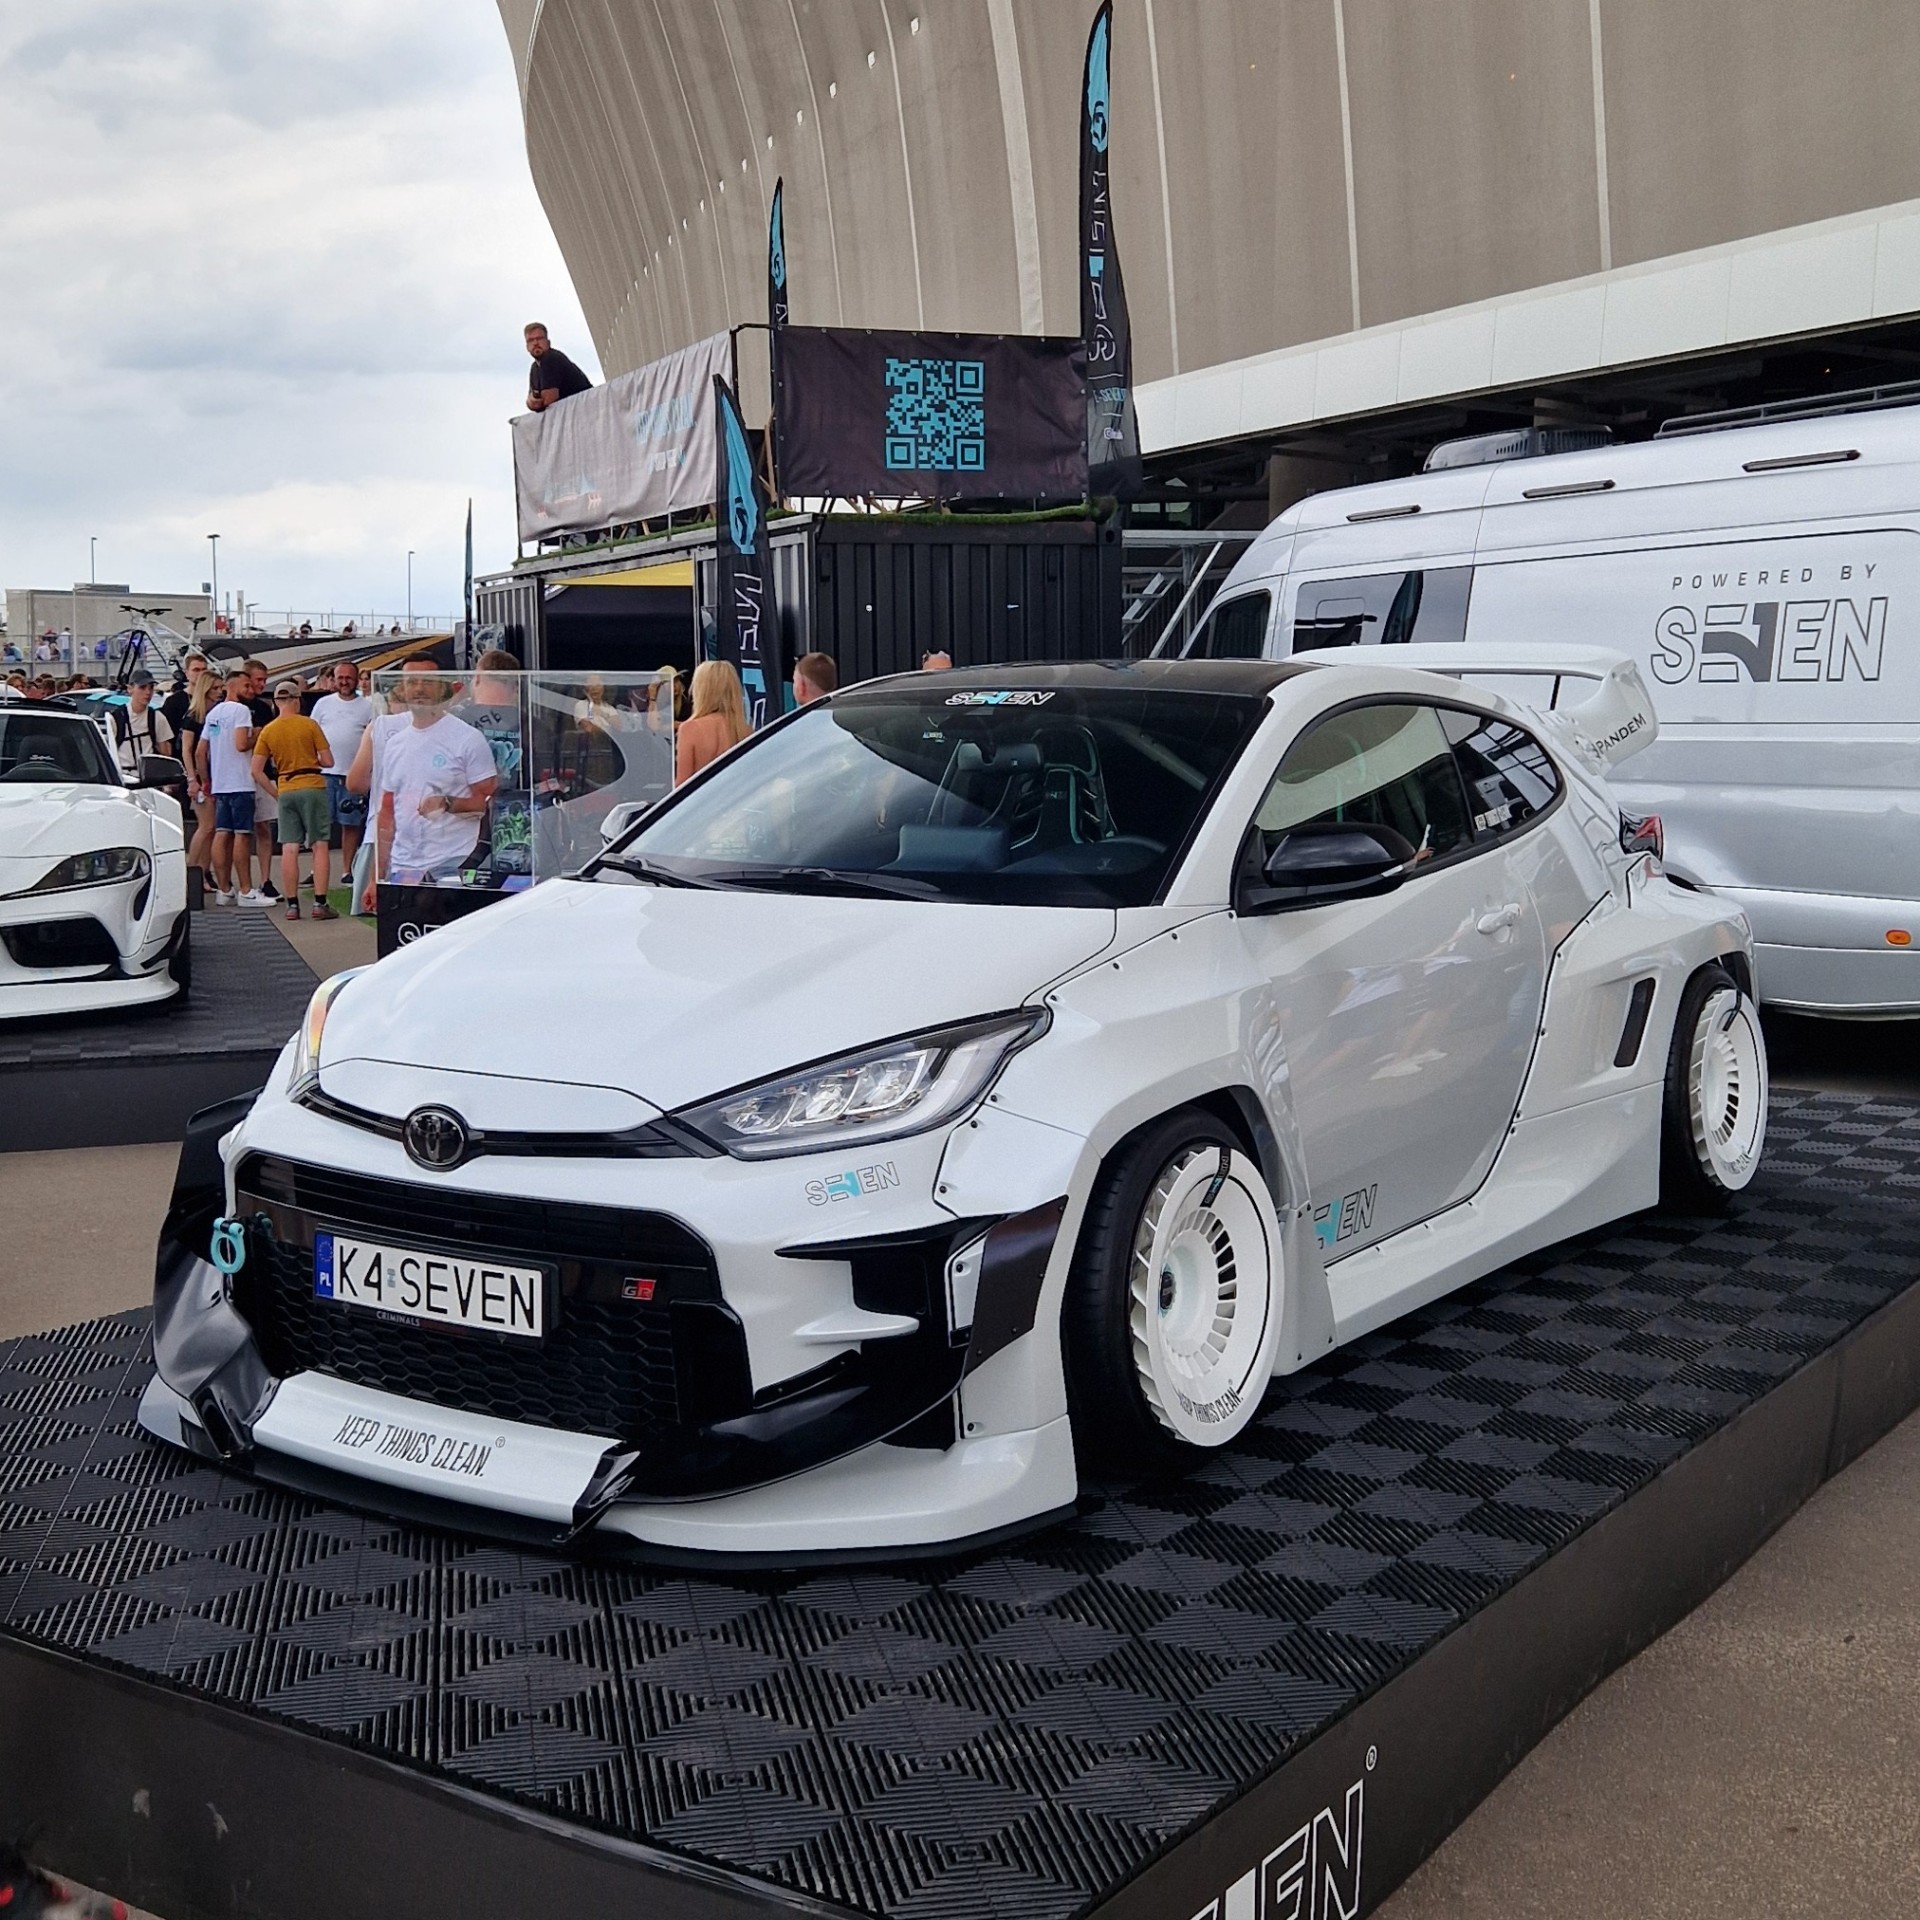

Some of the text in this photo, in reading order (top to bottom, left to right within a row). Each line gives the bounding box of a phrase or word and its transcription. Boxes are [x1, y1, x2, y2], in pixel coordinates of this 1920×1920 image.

[1672, 563, 1877, 590] POWERED BY
[1595, 712, 1647, 756] PANDEM
[319, 1271, 332, 1288] PL
[339, 1244, 535, 1330] K4 SEVEN
[623, 1284, 653, 1298] GR
[376, 1310, 421, 1328] CRIMINALS
[333, 1414, 381, 1449] KEEP
[375, 1424, 437, 1463] THINGS
